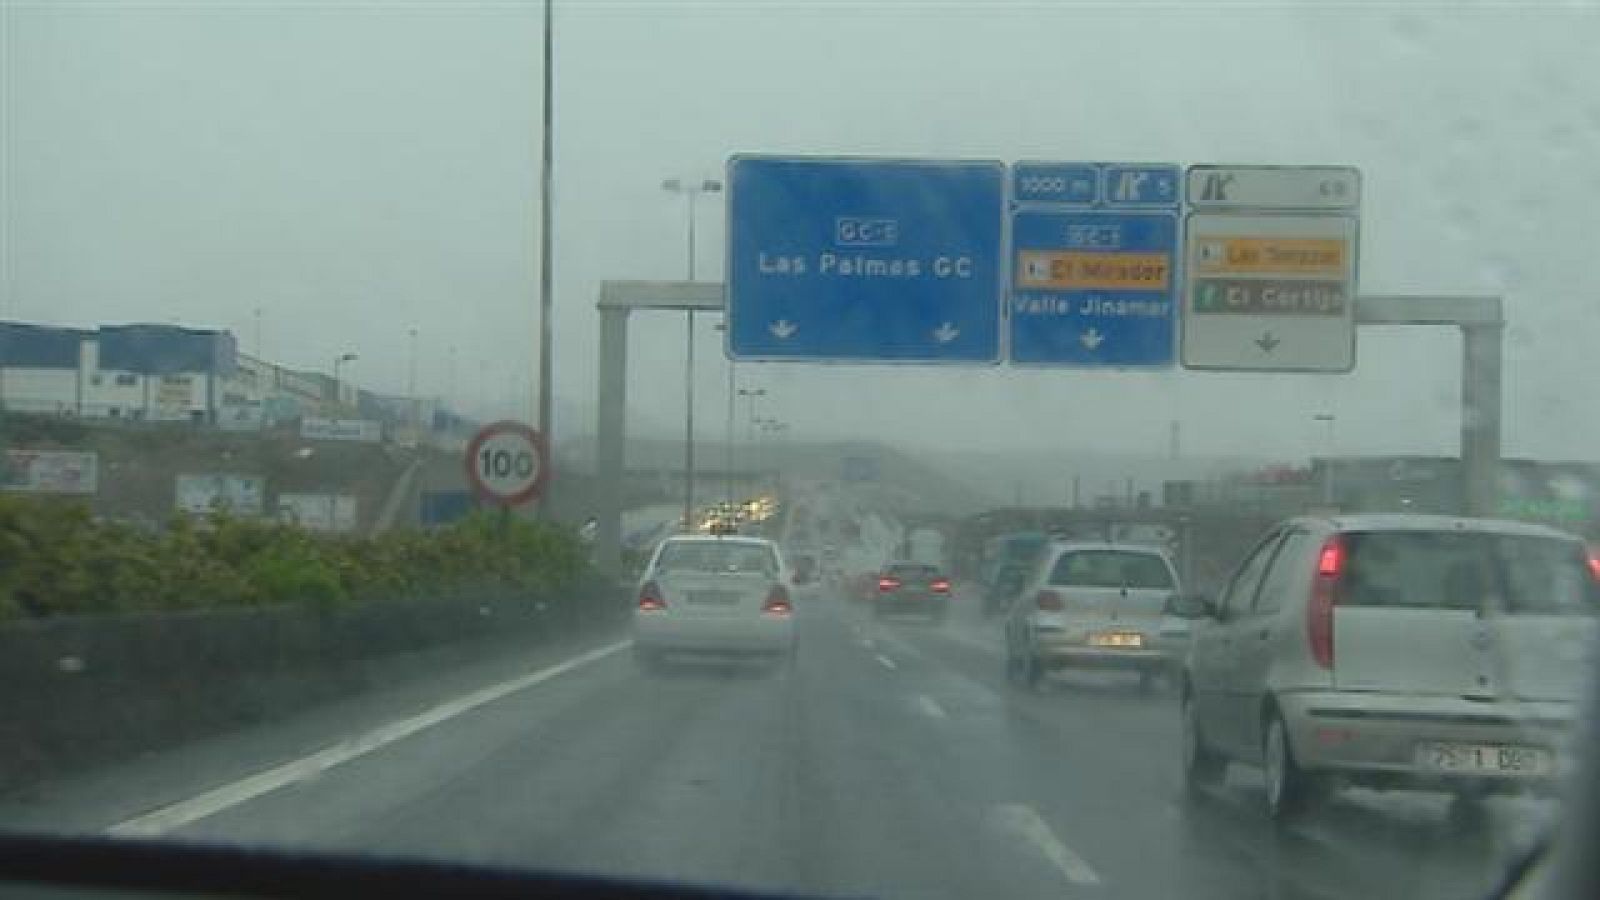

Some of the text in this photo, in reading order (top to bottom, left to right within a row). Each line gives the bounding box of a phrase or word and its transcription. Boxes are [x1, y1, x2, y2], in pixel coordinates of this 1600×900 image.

[759, 252, 972, 279] Las Palmas GC
[1052, 259, 1074, 280] El
[1014, 295, 1070, 315] Valle
[1226, 286, 1250, 306] El
[480, 449, 534, 478] 100
